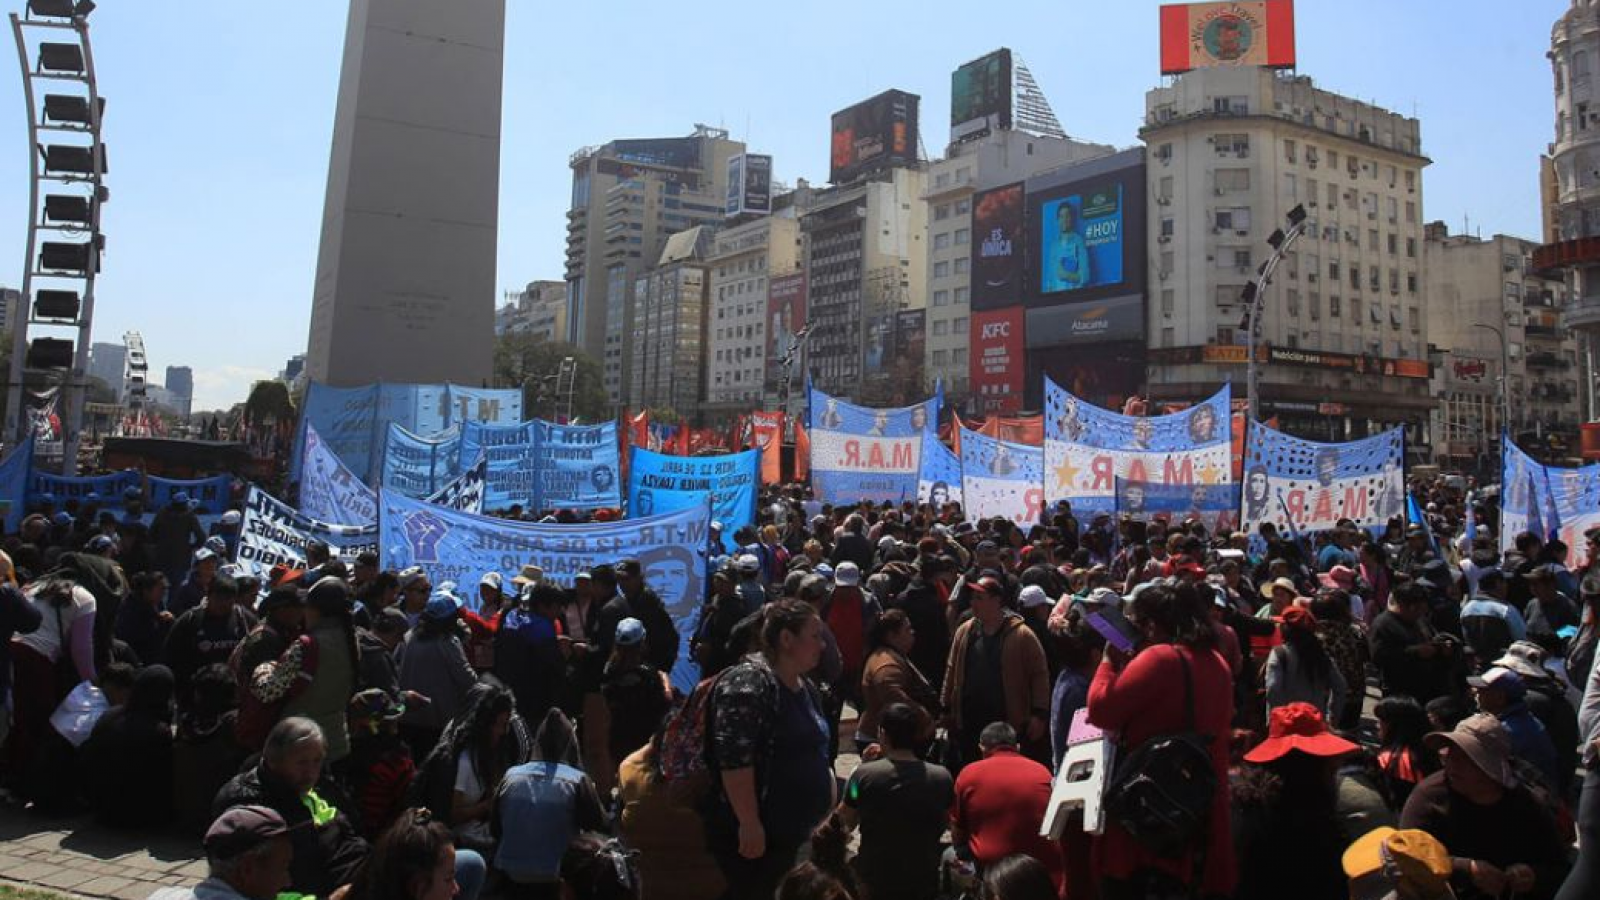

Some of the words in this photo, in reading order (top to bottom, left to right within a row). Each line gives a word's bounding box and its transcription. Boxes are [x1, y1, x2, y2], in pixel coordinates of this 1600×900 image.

[991, 228, 1002, 241] ES
[1085, 219, 1119, 238] #HOY
[982, 322, 1010, 340] KFC
